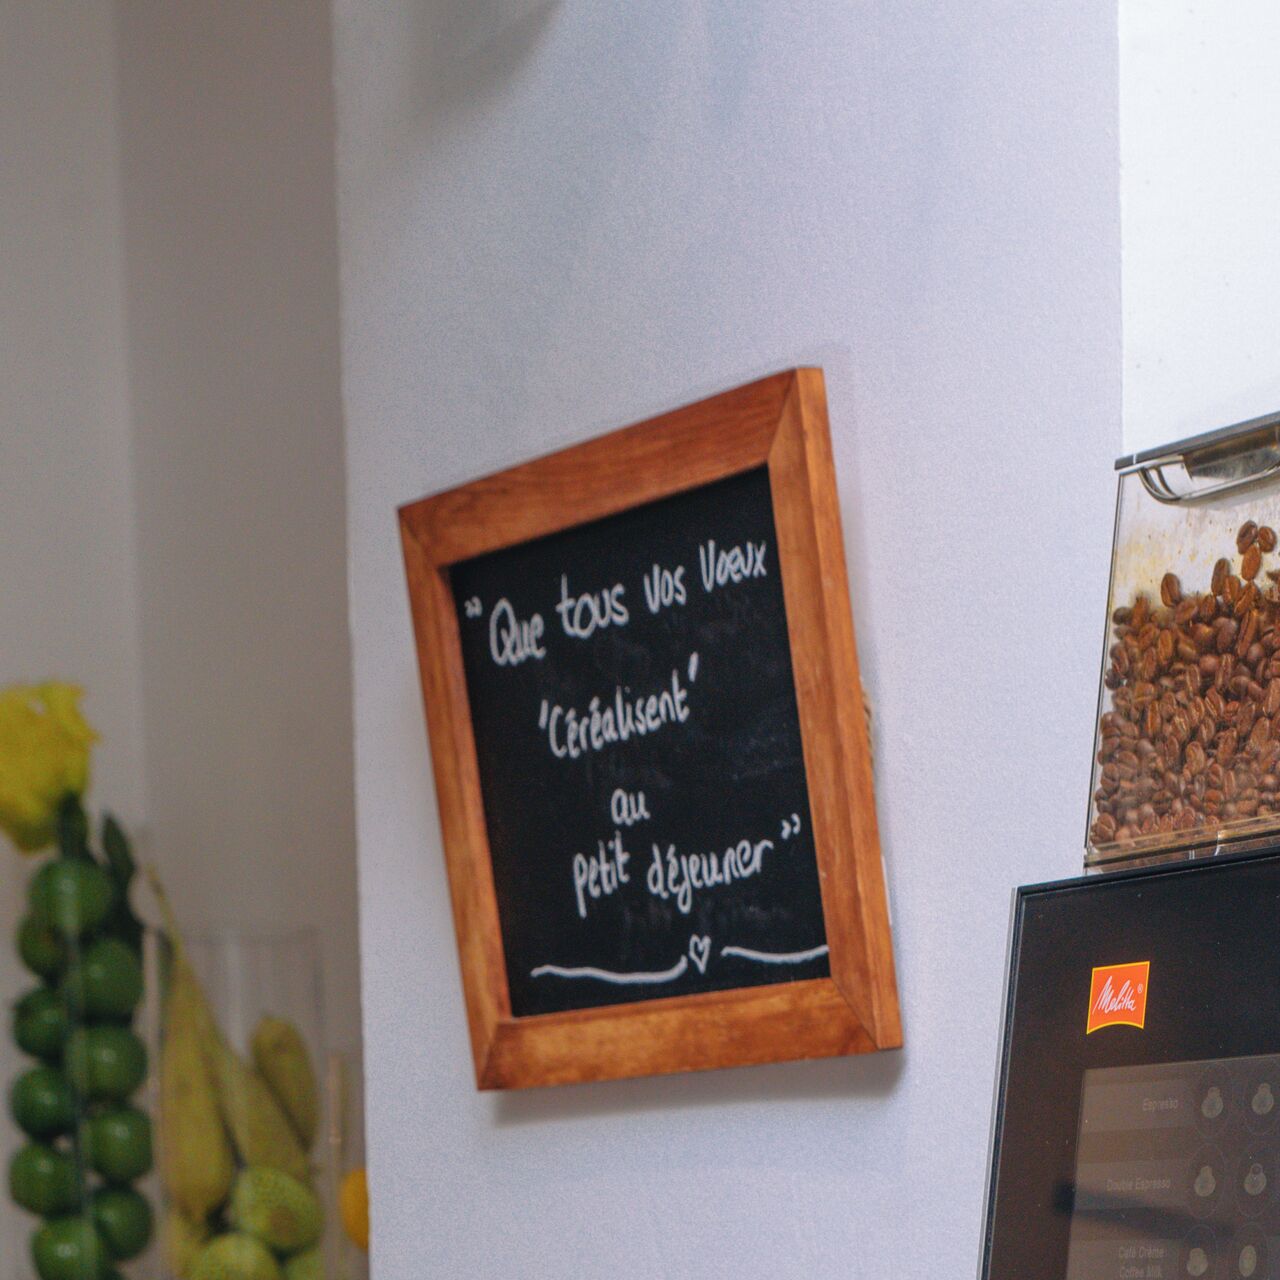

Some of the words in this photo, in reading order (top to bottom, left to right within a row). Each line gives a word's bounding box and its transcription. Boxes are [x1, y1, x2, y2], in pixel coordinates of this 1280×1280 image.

[556, 573, 629, 639] tous
[611, 788, 650, 826] au
[573, 830, 631, 918] petit
